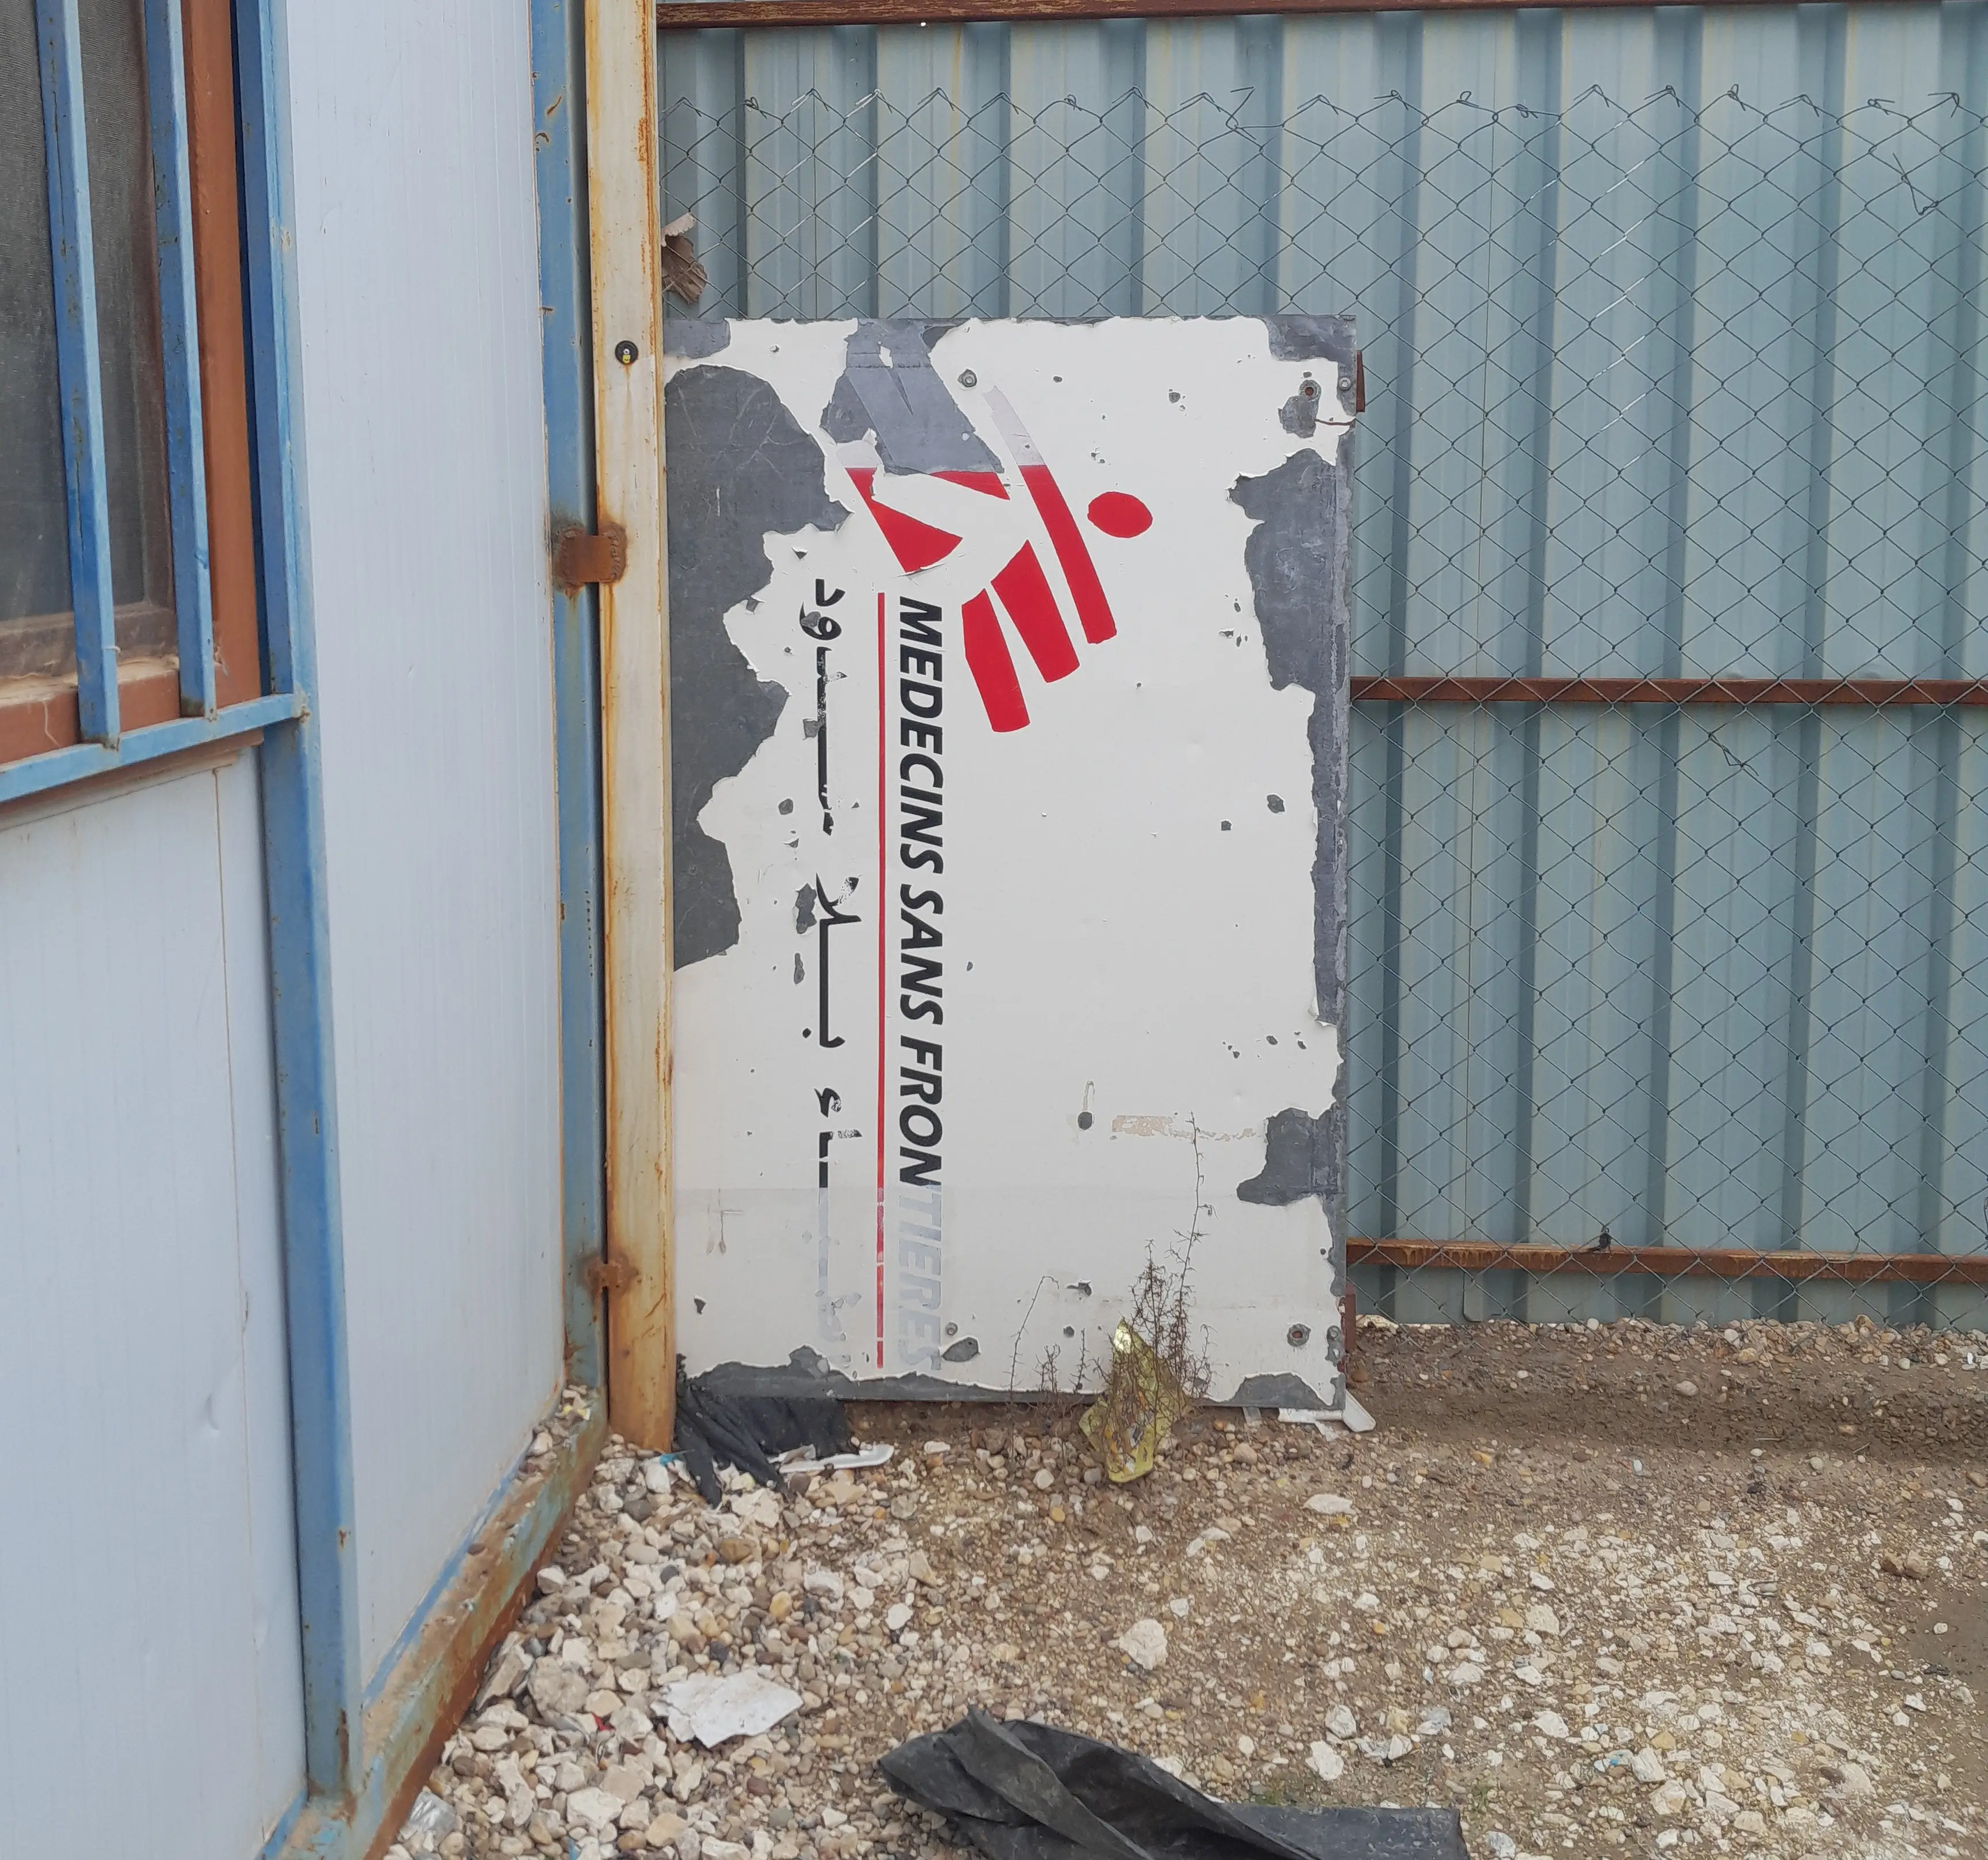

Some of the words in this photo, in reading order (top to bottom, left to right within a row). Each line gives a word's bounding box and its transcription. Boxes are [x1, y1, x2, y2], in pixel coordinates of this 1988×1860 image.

[899, 595, 944, 874] MEDECINS
[801, 872, 862, 1048] بلا
[899, 883, 944, 1025] SANS
[898, 1034, 943, 1370] FRONTIERES
